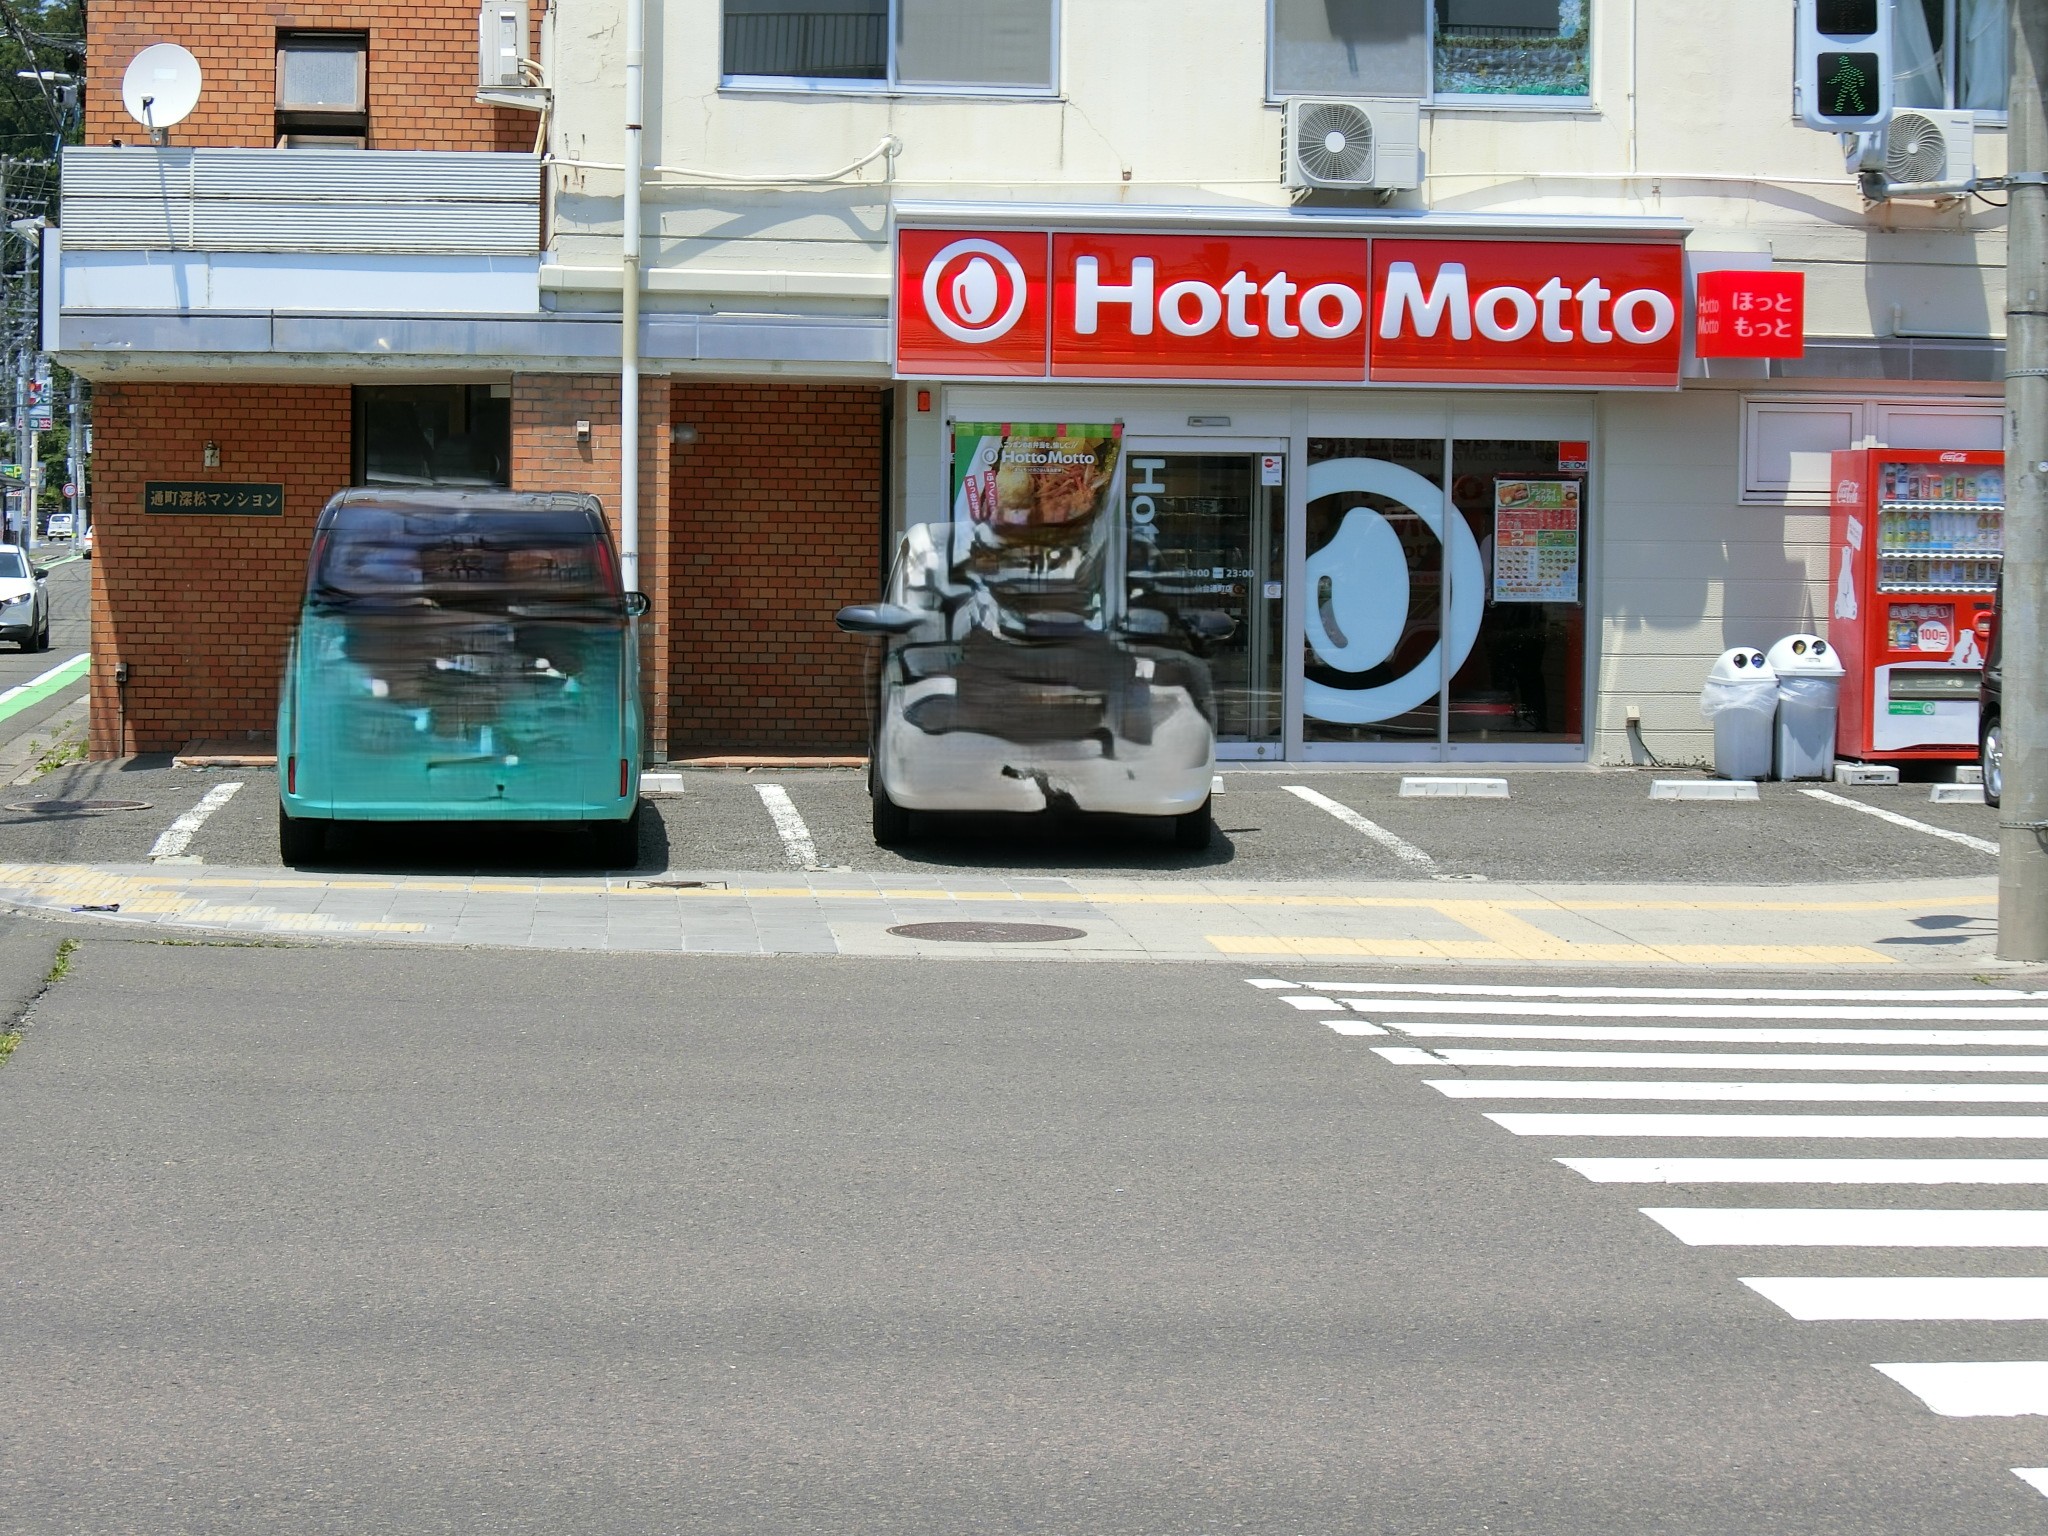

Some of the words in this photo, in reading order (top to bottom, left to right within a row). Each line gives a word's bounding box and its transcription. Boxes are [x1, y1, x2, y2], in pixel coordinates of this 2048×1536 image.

[1074, 254, 1363, 338] Hotto
[1379, 261, 1675, 345] Motto
[1698, 296, 1719, 314] Hotto
[1732, 292, 1792, 312] ほっと
[1697, 316, 1719, 334] Motto
[1734, 316, 1792, 338] もっと
[1002, 450, 1047, 464] Hotto
[1048, 451, 1095, 464] Motto
[1560, 461, 1587, 469] SECOM
[150, 490, 279, 508] 通町深松マンション
[1225, 569, 1255, 578] 23:00
